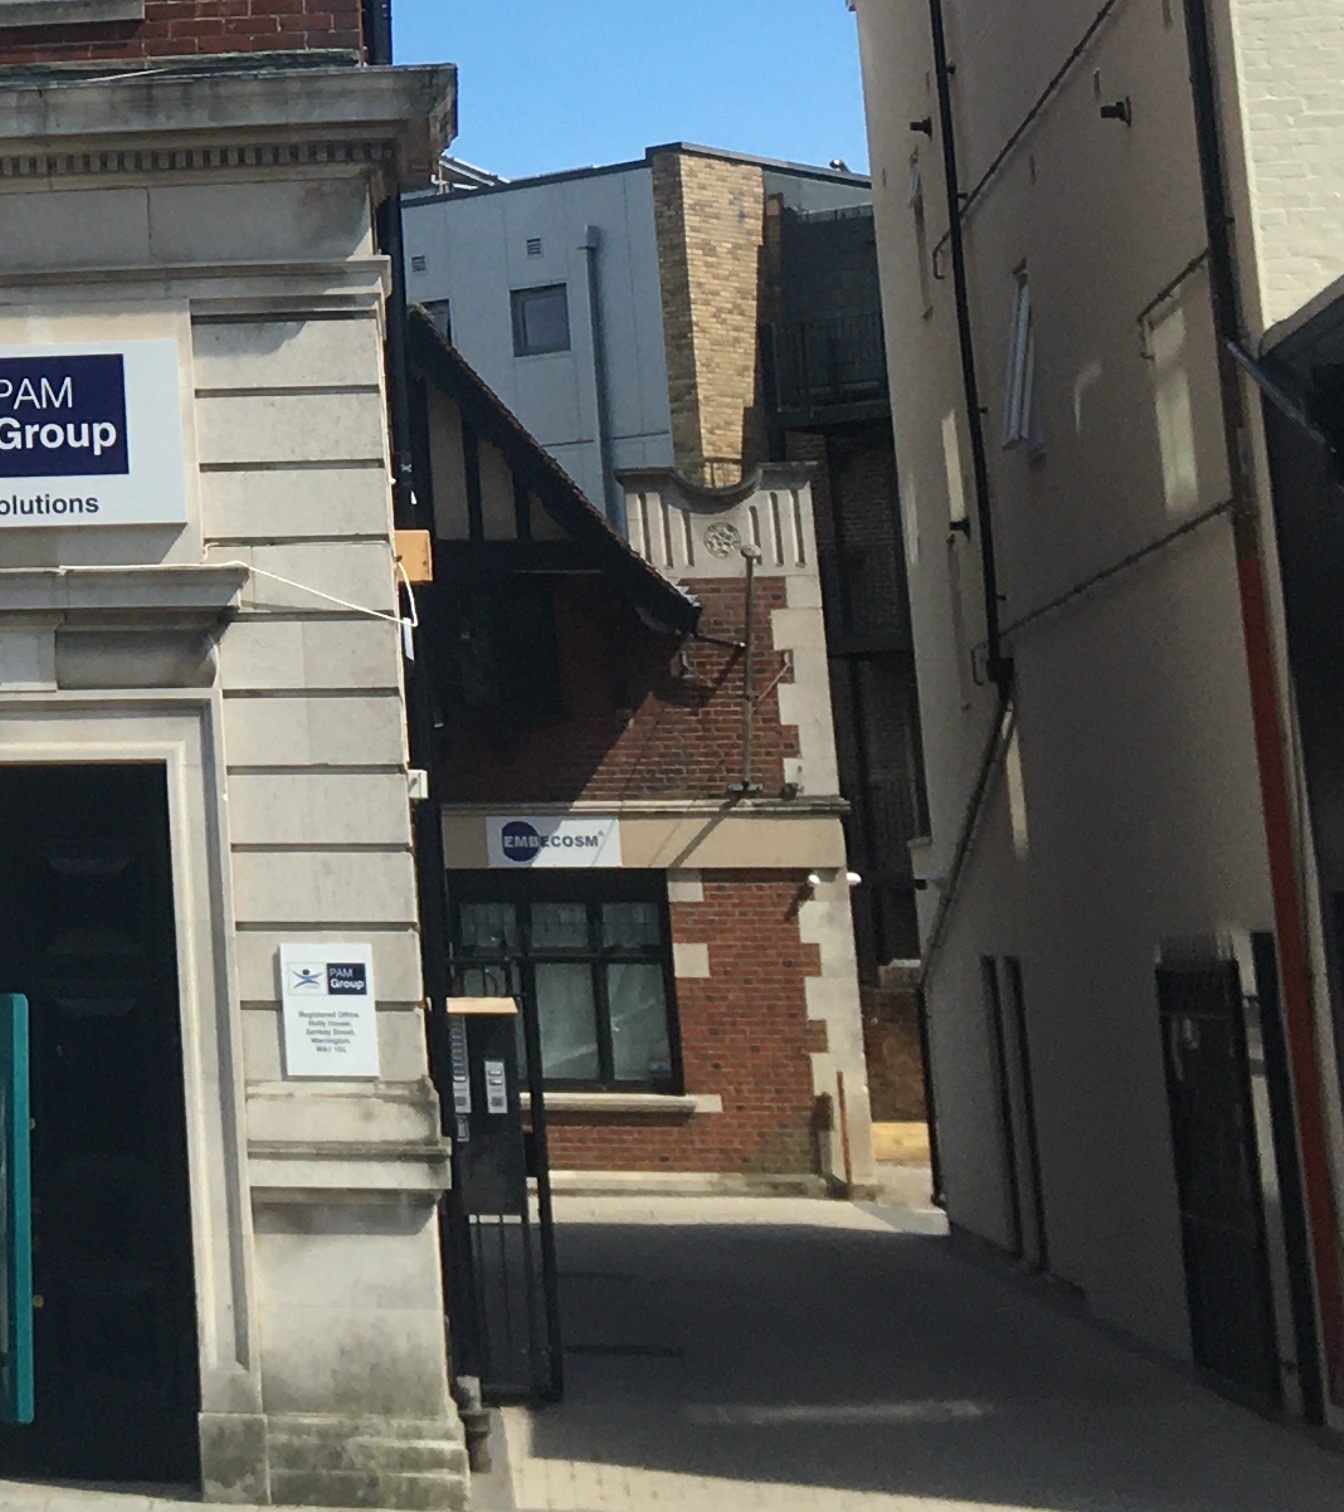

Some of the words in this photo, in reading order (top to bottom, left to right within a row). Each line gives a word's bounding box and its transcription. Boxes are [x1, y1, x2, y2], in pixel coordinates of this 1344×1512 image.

[504, 835, 599, 847] EMBECOSM
[329, 967, 353, 977] PAM
[330, 978, 365, 990] Group
